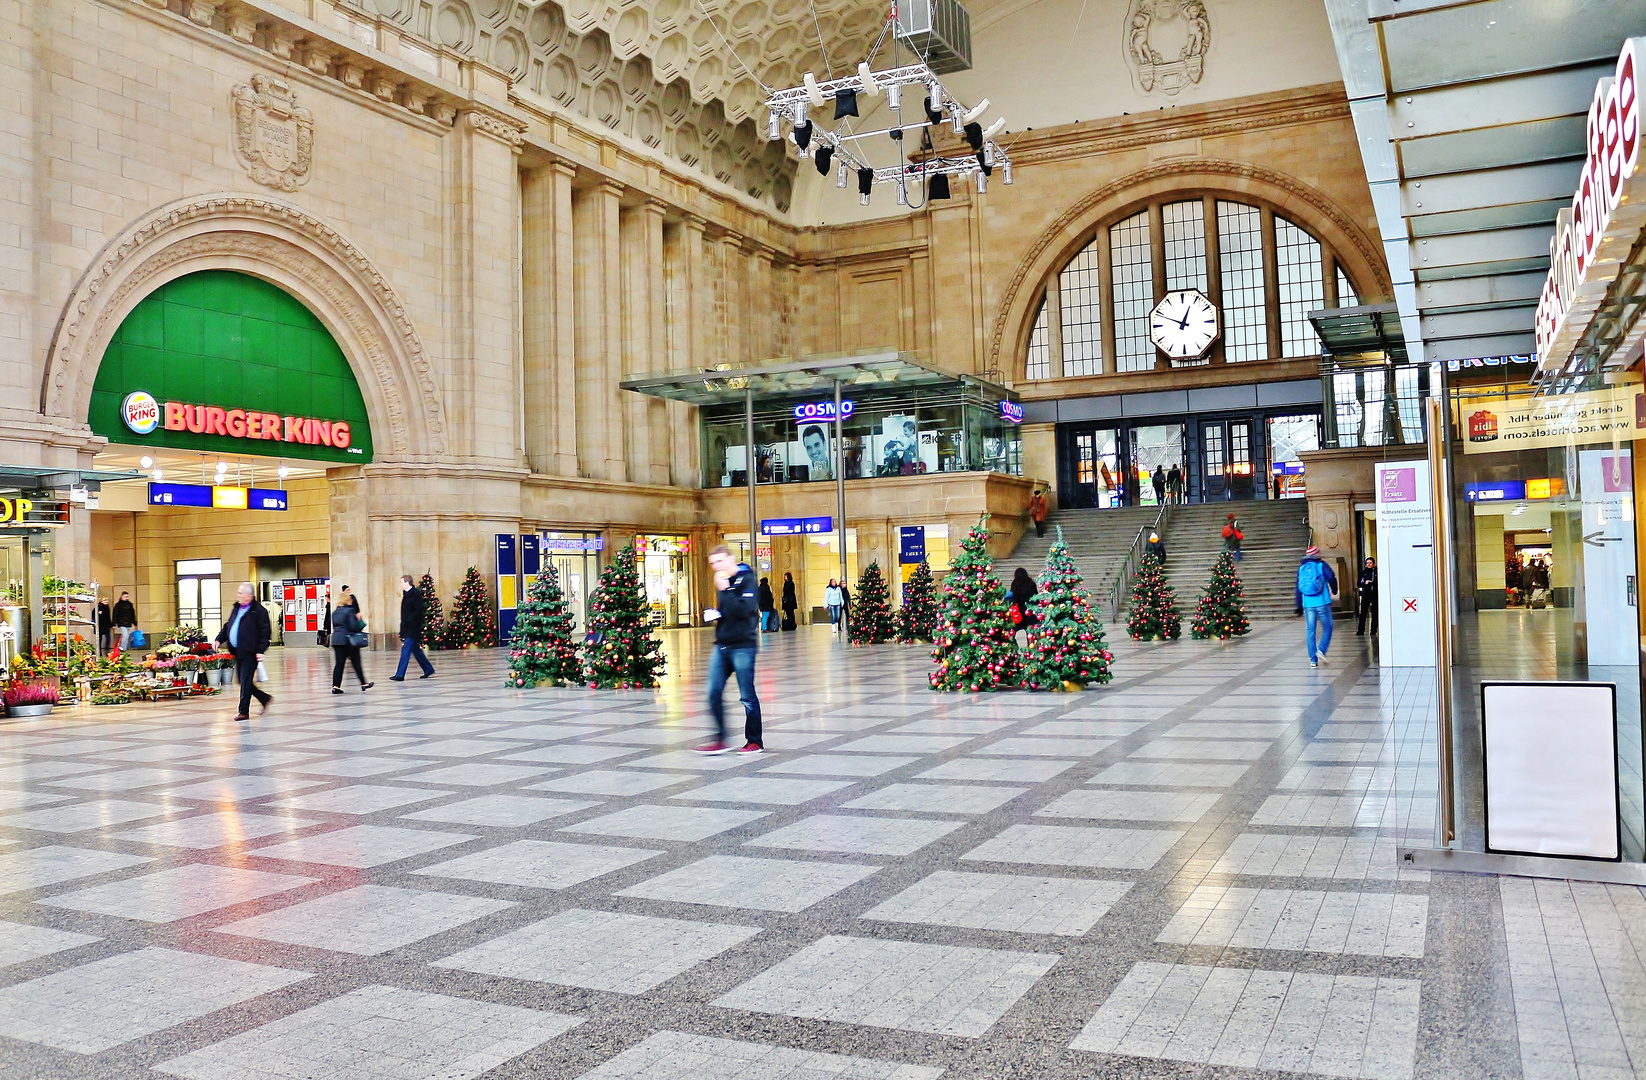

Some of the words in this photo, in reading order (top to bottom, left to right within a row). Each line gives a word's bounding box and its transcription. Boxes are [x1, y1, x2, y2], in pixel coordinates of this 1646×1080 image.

[1572, 37, 1640, 286] coffee
[129, 401, 155, 412] BURGER
[795, 401, 853, 417] COSMO
[1002, 402, 1023, 418] COSMO
[130, 408, 156, 423] KING
[164, 401, 282, 442] BURGER
[284, 416, 351, 449] KING
